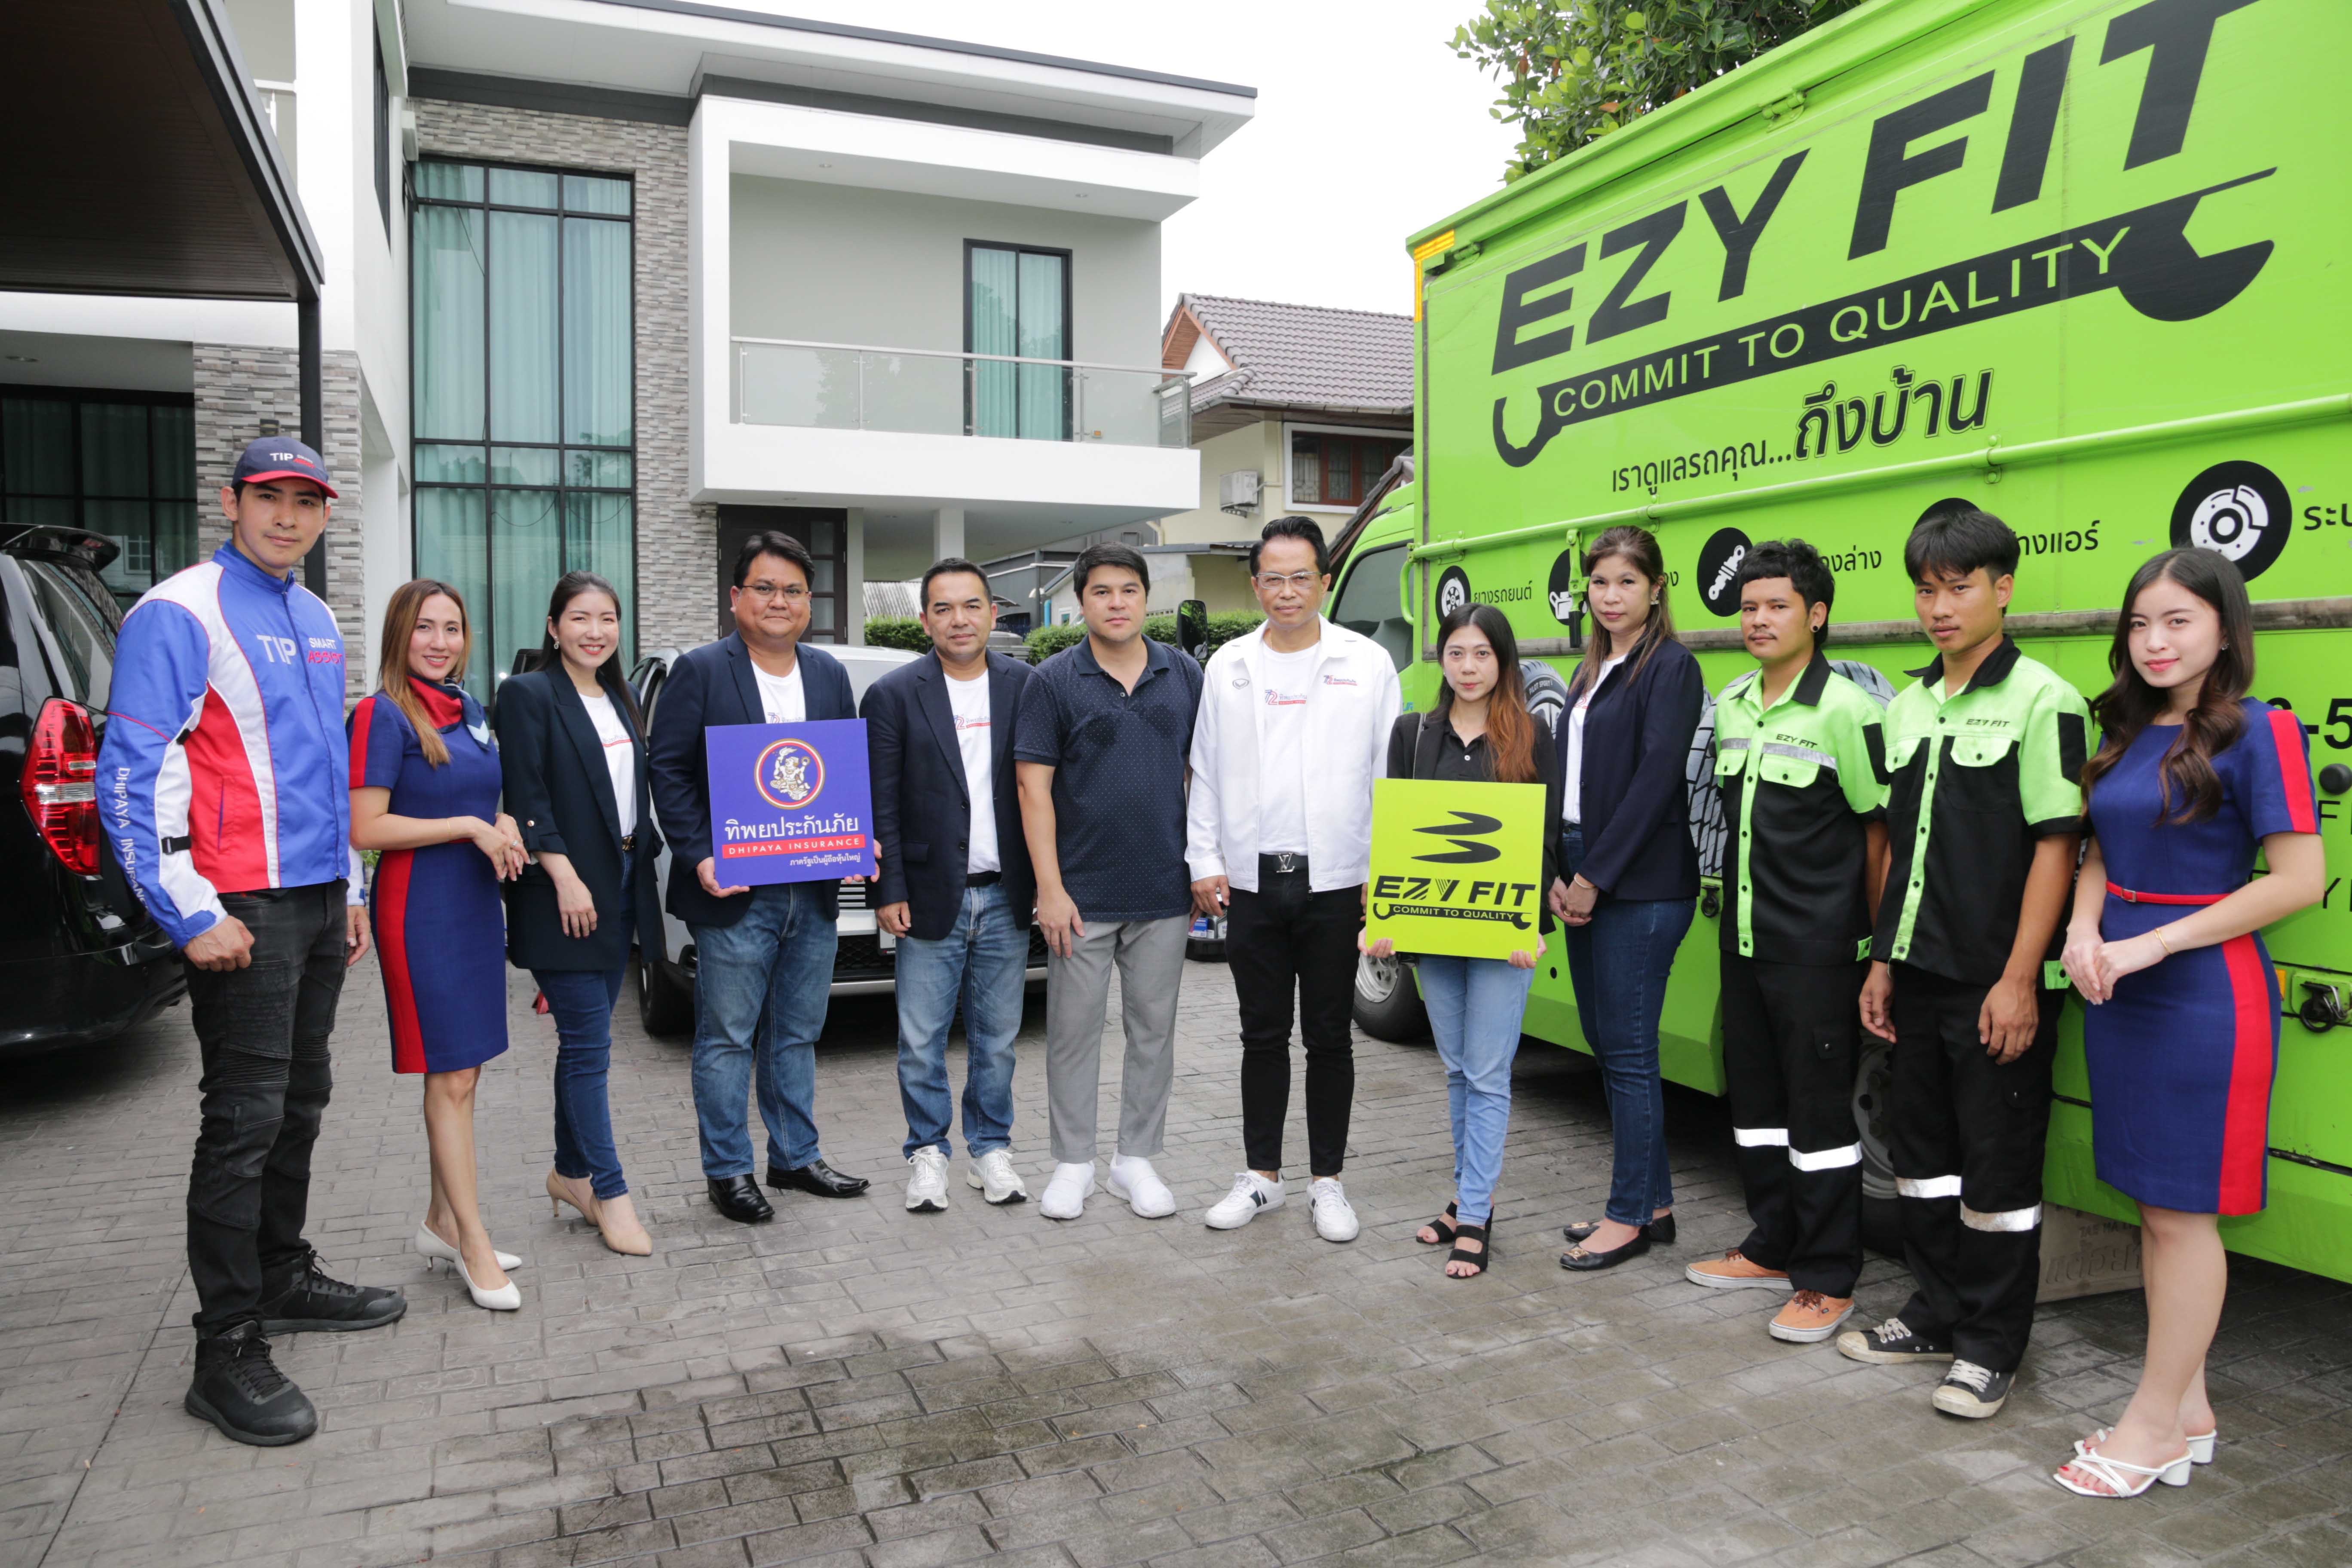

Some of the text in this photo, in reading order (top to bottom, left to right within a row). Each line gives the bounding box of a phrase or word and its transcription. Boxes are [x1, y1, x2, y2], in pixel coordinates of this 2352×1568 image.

[1491, 0, 2257, 375] EZY FIT
[1553, 226, 2131, 417] COMMIT TO QUALITY
[270, 453, 293, 461] TIP
[2014, 519, 2101, 556] างแอร์
[1474, 580, 1532, 603] ยางรถยนต์
[257, 634, 337, 665] TIP SMART
[308, 650, 343, 664] ASSIST
[1265, 689, 1278, 705] 72
[1776, 733, 1818, 748] EZY FIT
[113, 767, 149, 910] DHIPAYA INSURANC
[725, 813, 859, 840] ทิพยประกันภัย
[729, 838, 860, 855] DHIPAYA INSURANCE
[1373, 875, 1536, 906] EZY FIT
[1393, 906, 1440, 915] COMMIT
[1463, 910, 1514, 920] QUALITY
